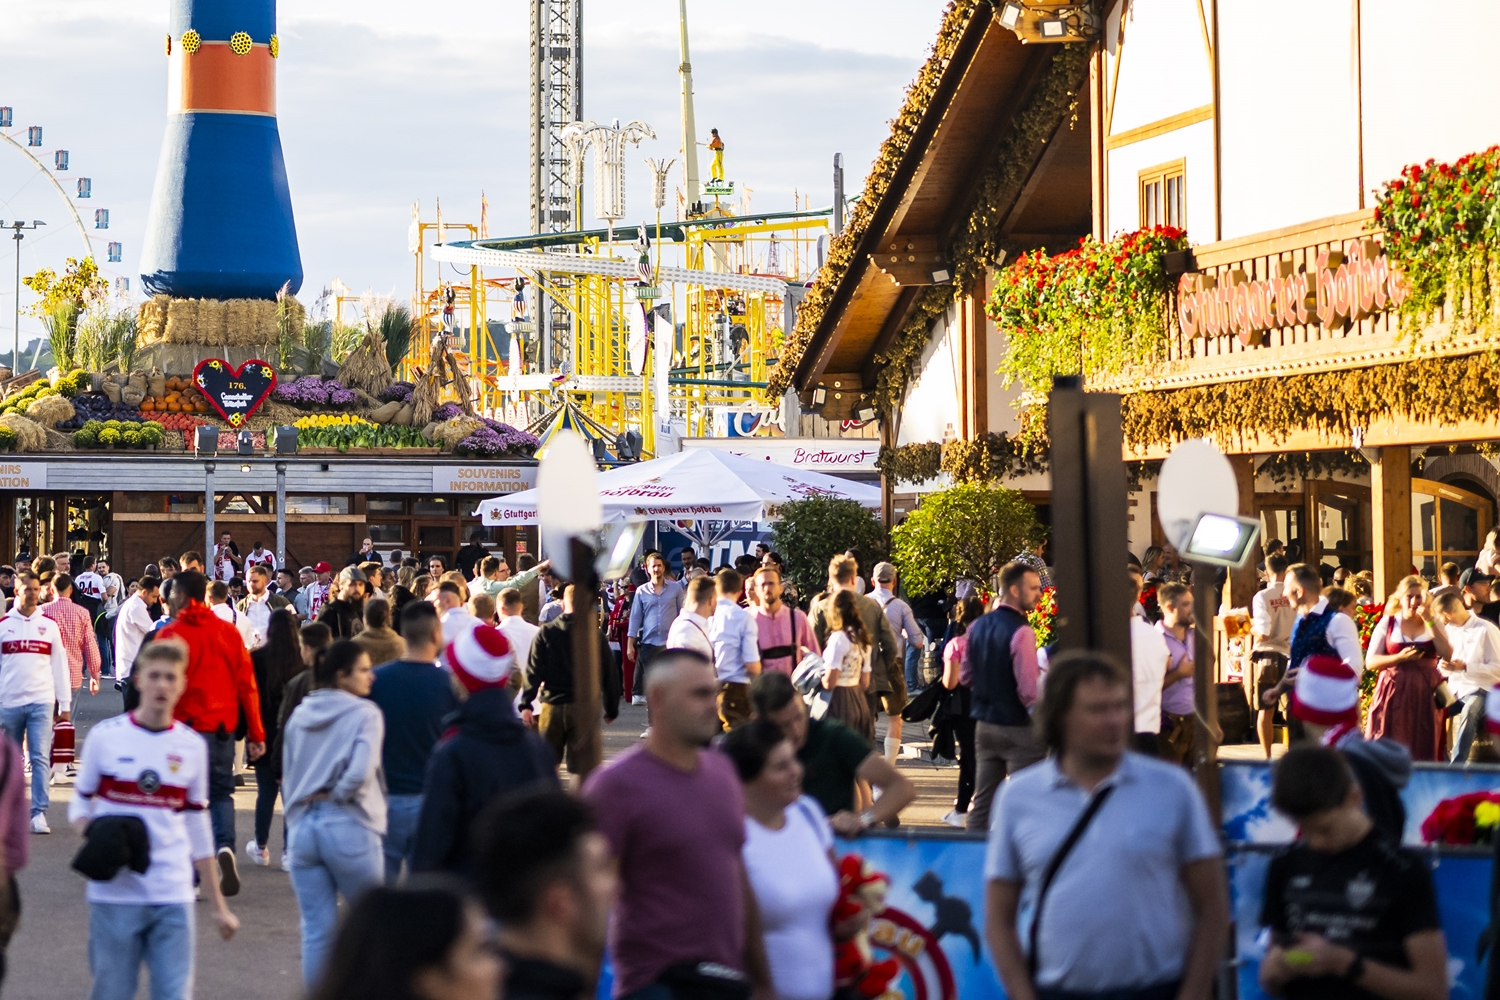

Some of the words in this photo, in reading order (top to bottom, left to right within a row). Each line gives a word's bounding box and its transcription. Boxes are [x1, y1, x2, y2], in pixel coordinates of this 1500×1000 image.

[1177, 261, 1309, 347] Stuttgarter
[229, 382, 247, 390] 176.
[793, 447, 878, 464] Bratwurst
[458, 468, 521, 479] SOUVENIRS
[450, 481, 529, 491] INFORMATION
[648, 507, 690, 516] Stuttgarter
[690, 506, 722, 514] Hofbräu
